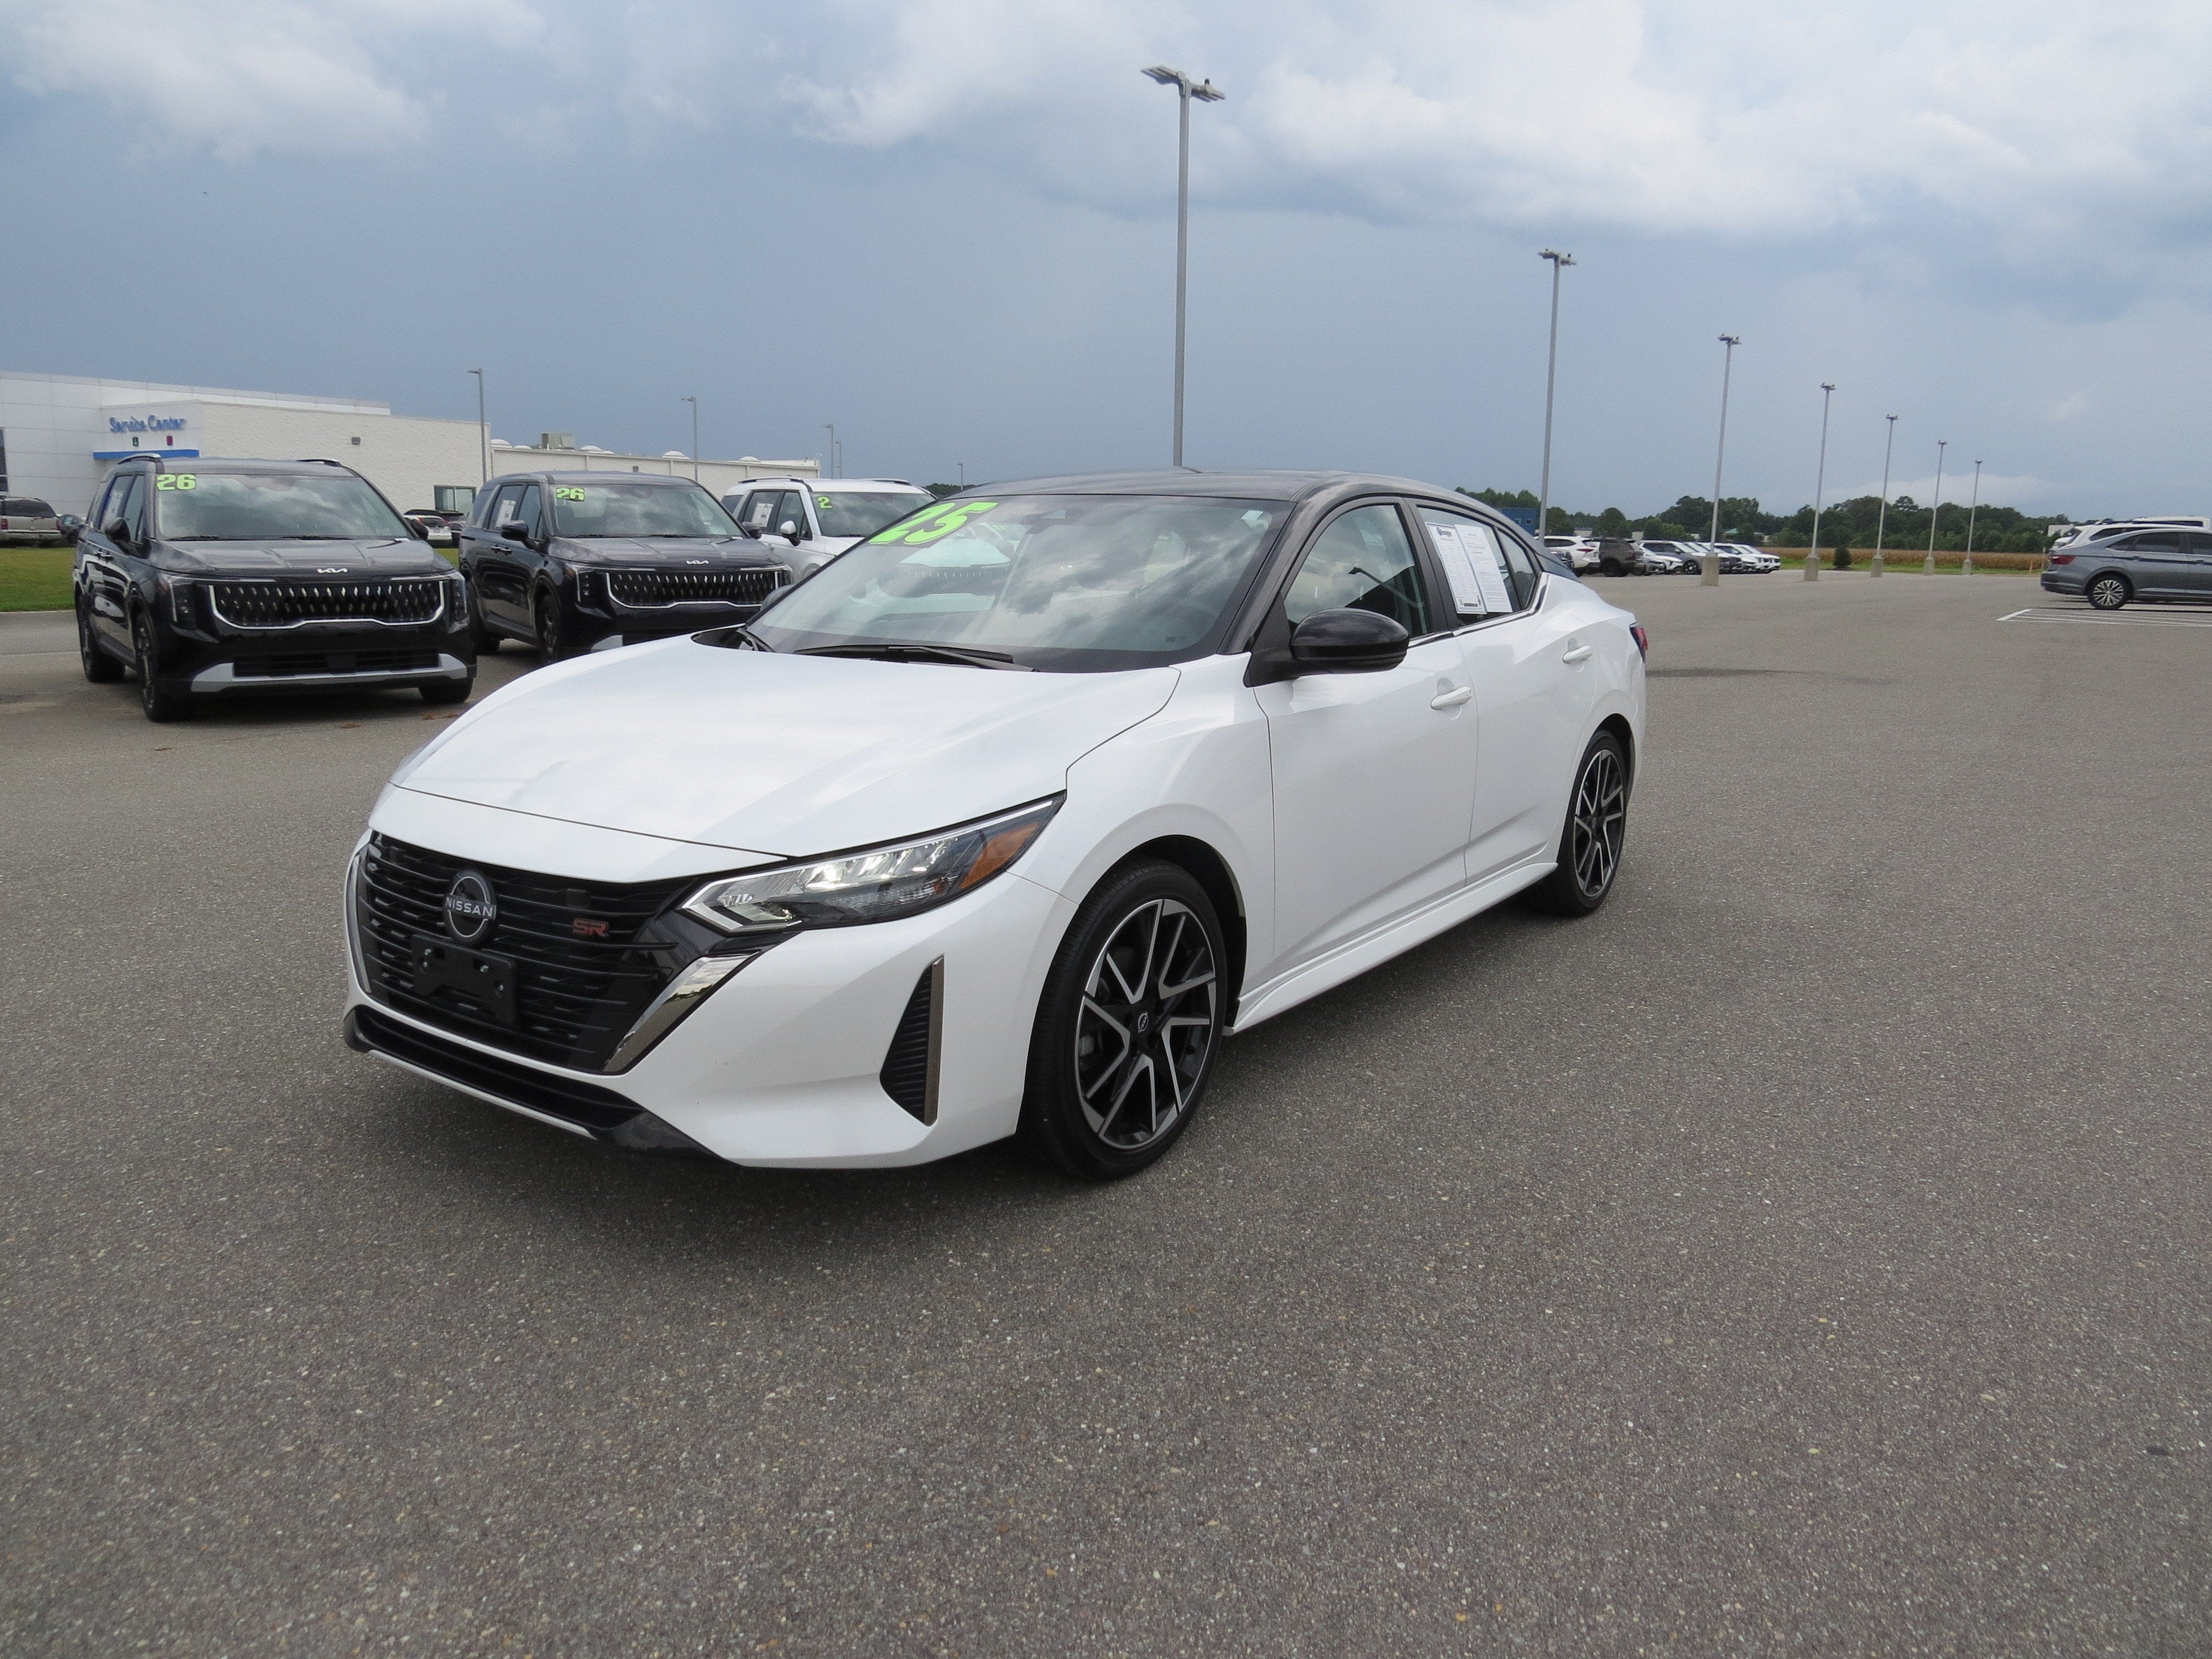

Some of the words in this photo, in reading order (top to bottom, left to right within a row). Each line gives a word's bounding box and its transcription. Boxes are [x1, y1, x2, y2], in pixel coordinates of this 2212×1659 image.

[110, 416, 148, 433] Service
[148, 415, 186, 431] Center
[158, 474, 196, 491] 26
[556, 488, 584, 501] 26
[817, 496, 832, 509] 2
[868, 502, 998, 545] 25
[445, 896, 493, 917] NISSAN
[572, 919, 608, 937] SR
